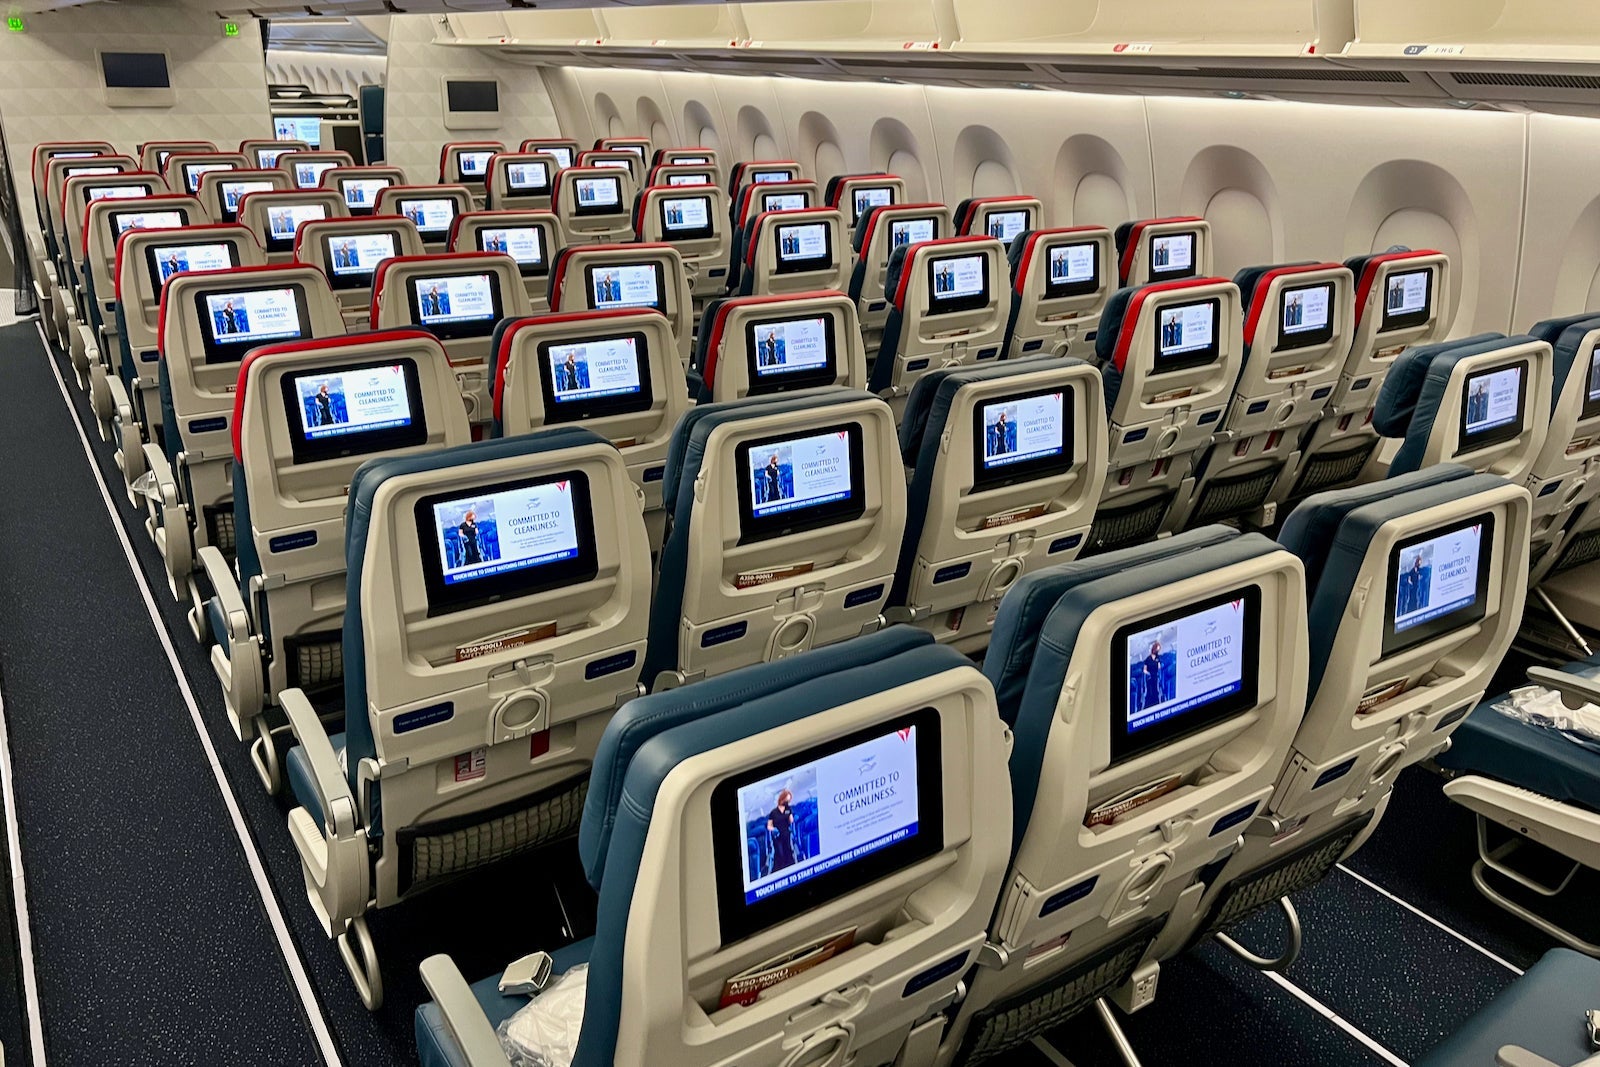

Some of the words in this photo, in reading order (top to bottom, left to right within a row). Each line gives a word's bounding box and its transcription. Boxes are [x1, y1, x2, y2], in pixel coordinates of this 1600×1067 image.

[508, 513, 549, 527] COMMITTED
[514, 520, 558, 535] CLEANLINESS.
[1186, 638, 1222, 658] COMMITTED
[1223, 635, 1231, 644] TO
[834, 776, 886, 804] COMMITTED
[888, 771, 899, 783] TO
[840, 786, 897, 816] CLEANLINESS.
[755, 882, 774, 898] TOUCH
[774, 877, 788, 890] HERE
[789, 873, 796, 884] TO
[797, 866, 812, 880] START
[814, 855, 840, 873] WATCHING
[841, 850, 852, 862] FREE
[853, 834, 892, 857] ENTERTAINMENT
[893, 828, 905, 840] NOW
[730, 984, 759, 996] SAFETY
